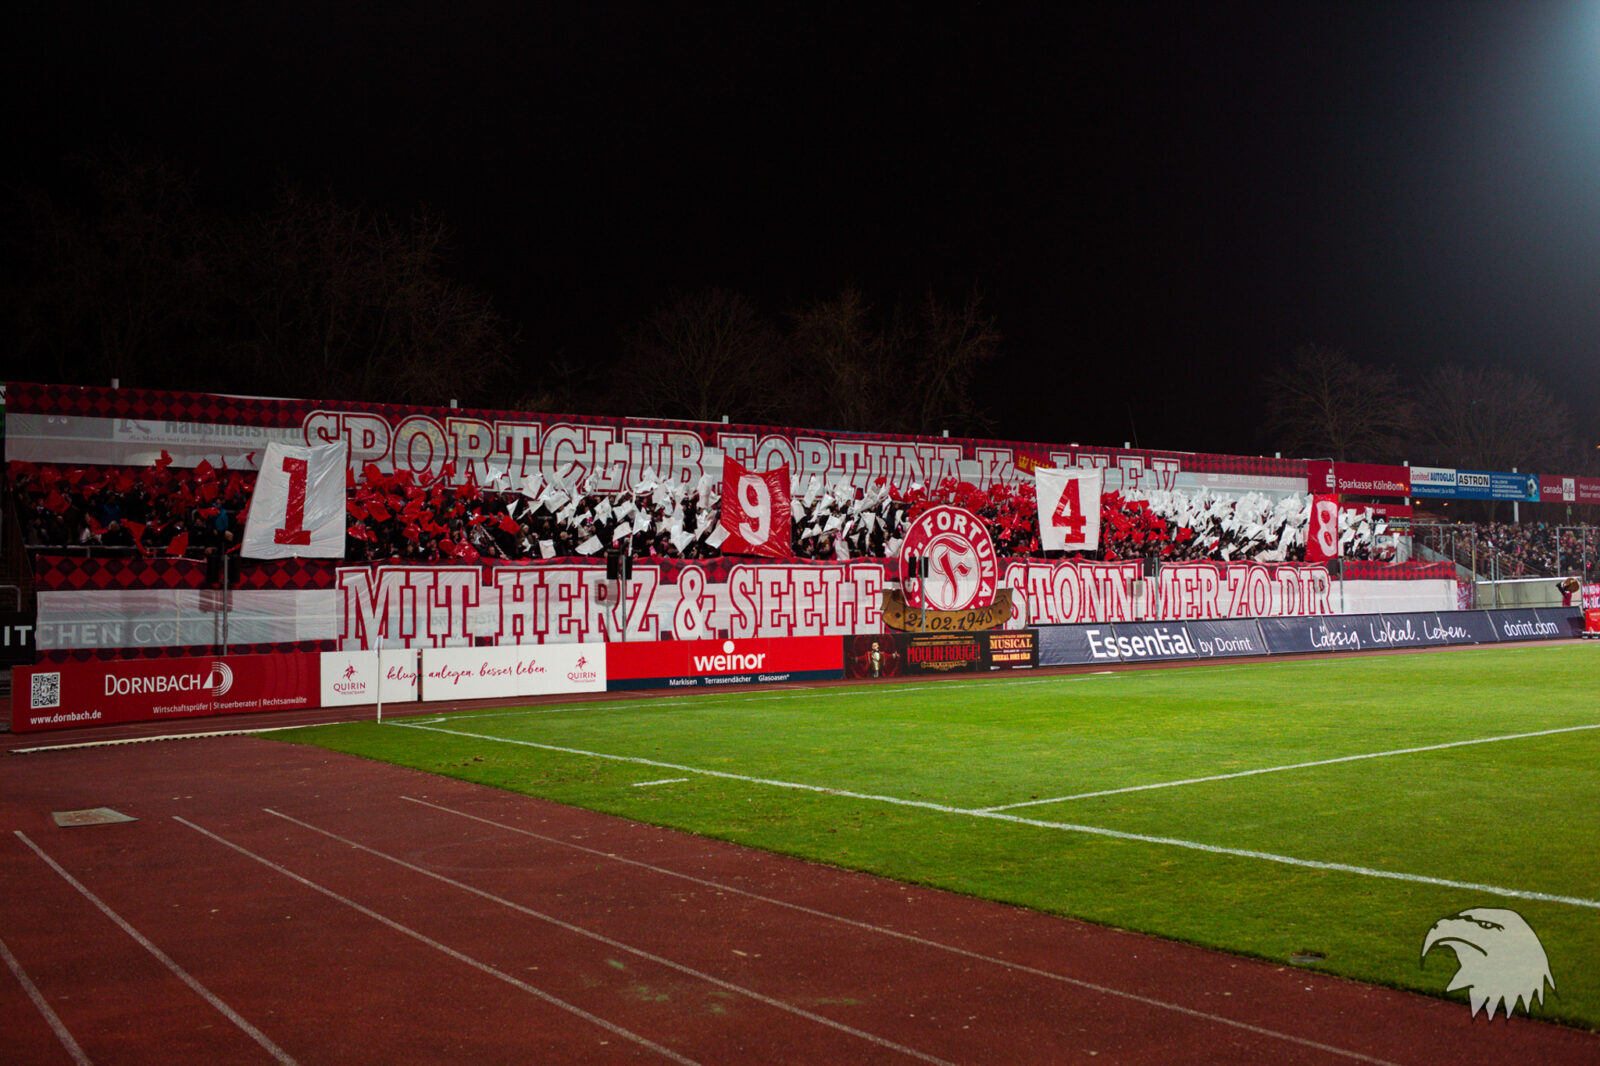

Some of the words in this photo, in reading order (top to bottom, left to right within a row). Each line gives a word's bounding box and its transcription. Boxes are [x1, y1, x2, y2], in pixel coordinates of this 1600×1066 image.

[1338, 478, 1372, 490] Sparkasse
[1373, 480, 1405, 491] KölnBonn
[1459, 475, 1489, 486] ASTRON
[1543, 485, 1562, 494] canada
[274, 456, 311, 546] 1
[737, 475, 772, 546] 9
[1052, 478, 1087, 544] 4
[1315, 500, 1338, 557] 8
[921, 511, 994, 598] FORTUNA
[1277, 566, 1334, 618] DIR
[336, 565, 482, 650] MIT
[493, 565, 660, 643] HERZ
[674, 564, 716, 641] &
[728, 563, 885, 639] SEELE
[1309, 626, 1366, 650] Lässig.
[1370, 619, 1420, 644] Lokal.
[1423, 617, 1472, 641] Leben.
[1503, 619, 1559, 638] dorint.com
[907, 647, 943, 662] MOULIN
[945, 645, 980, 661] ROUGE!
[990, 638, 1033, 650] MUSICAL
[1086, 629, 1196, 659] Essential
[1199, 638, 1215, 656] by
[1216, 637, 1253, 651] Dorint
[694, 640, 765, 671] weinor
[428, 665, 474, 686] anlegen.
[479, 661, 513, 677] besser
[516, 660, 548, 675] leben.
[567, 671, 596, 681] QUIRIN
[669, 678, 697, 686] Markisen
[704, 675, 751, 685] Terrassendächer
[105, 674, 201, 696] DORNBACH
[333, 682, 366, 692] QUIRIN
[153, 702, 208, 715] Wirtschaftsprüfer
[213, 699, 258, 710] Steuerberater
[263, 696, 307, 707] Rechtsanwälte
[30, 710, 102, 725] www.dornbach.de
